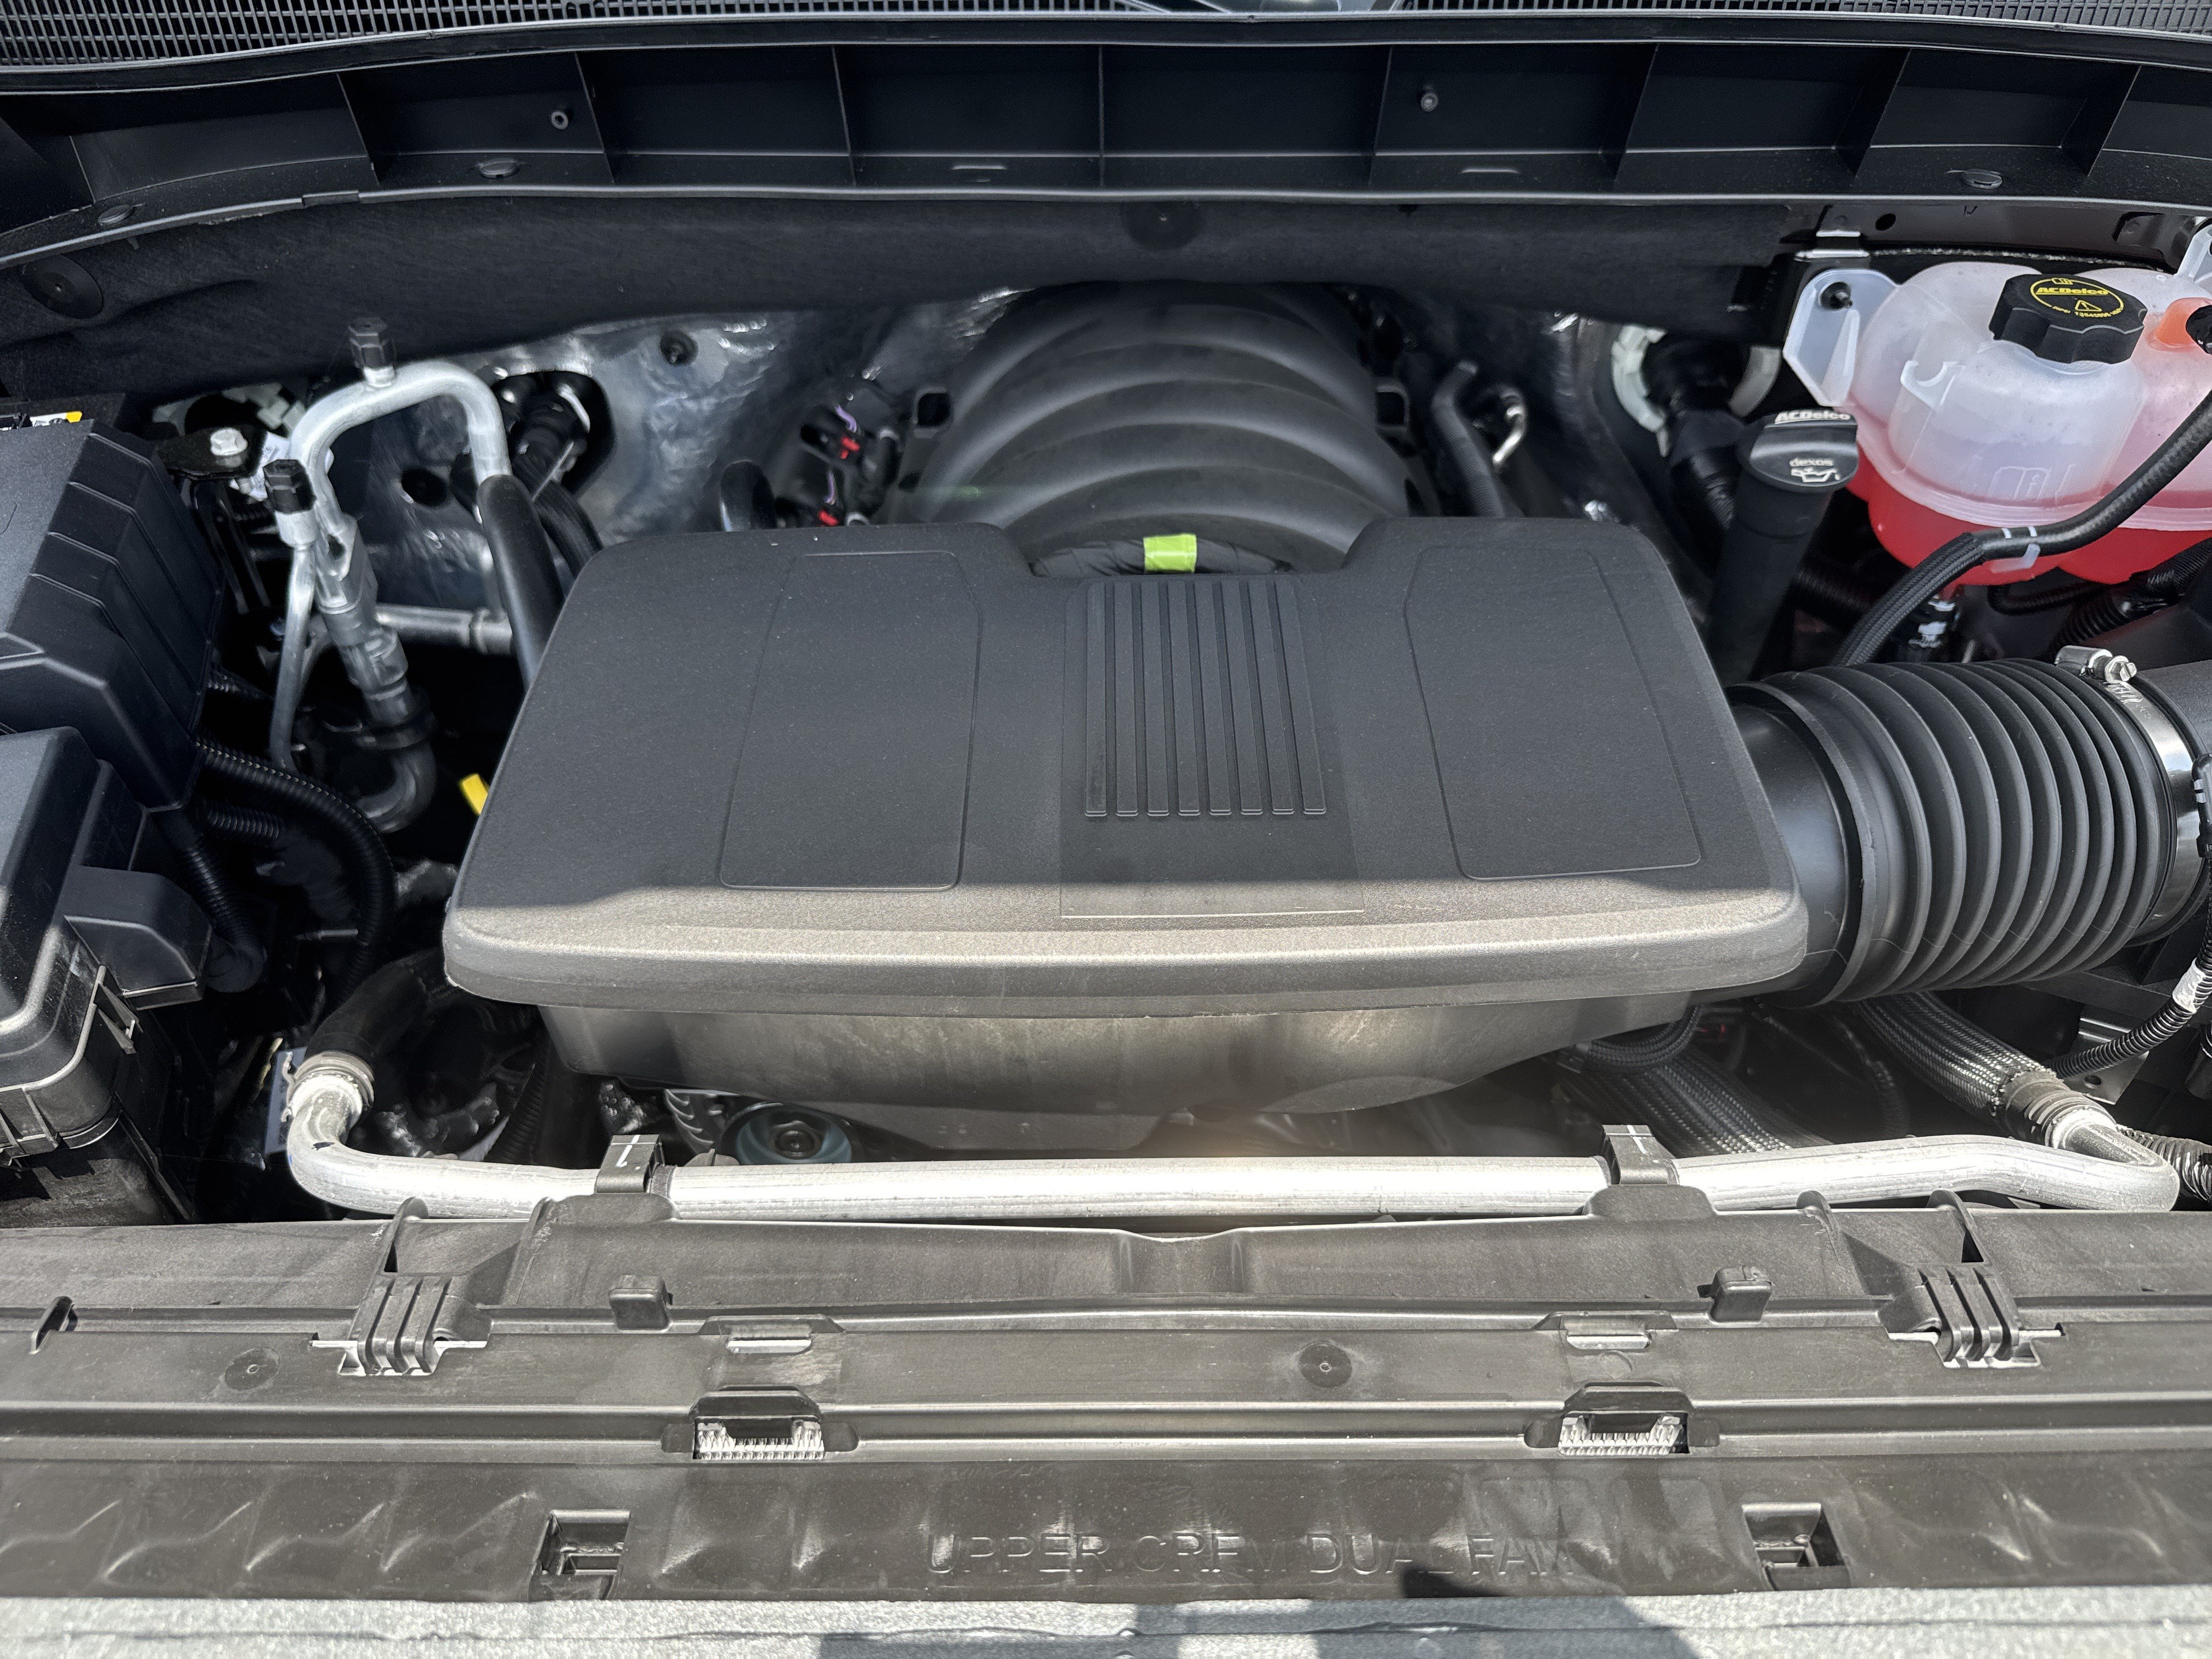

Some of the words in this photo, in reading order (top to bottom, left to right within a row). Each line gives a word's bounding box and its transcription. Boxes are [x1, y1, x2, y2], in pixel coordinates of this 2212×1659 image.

[2035, 287, 2109, 295] ACDelco
[1775, 410, 1852, 423] ACDelco
[929, 1533, 1113, 1573] UPPER
[1306, 1532, 1455, 1575] DUAL
